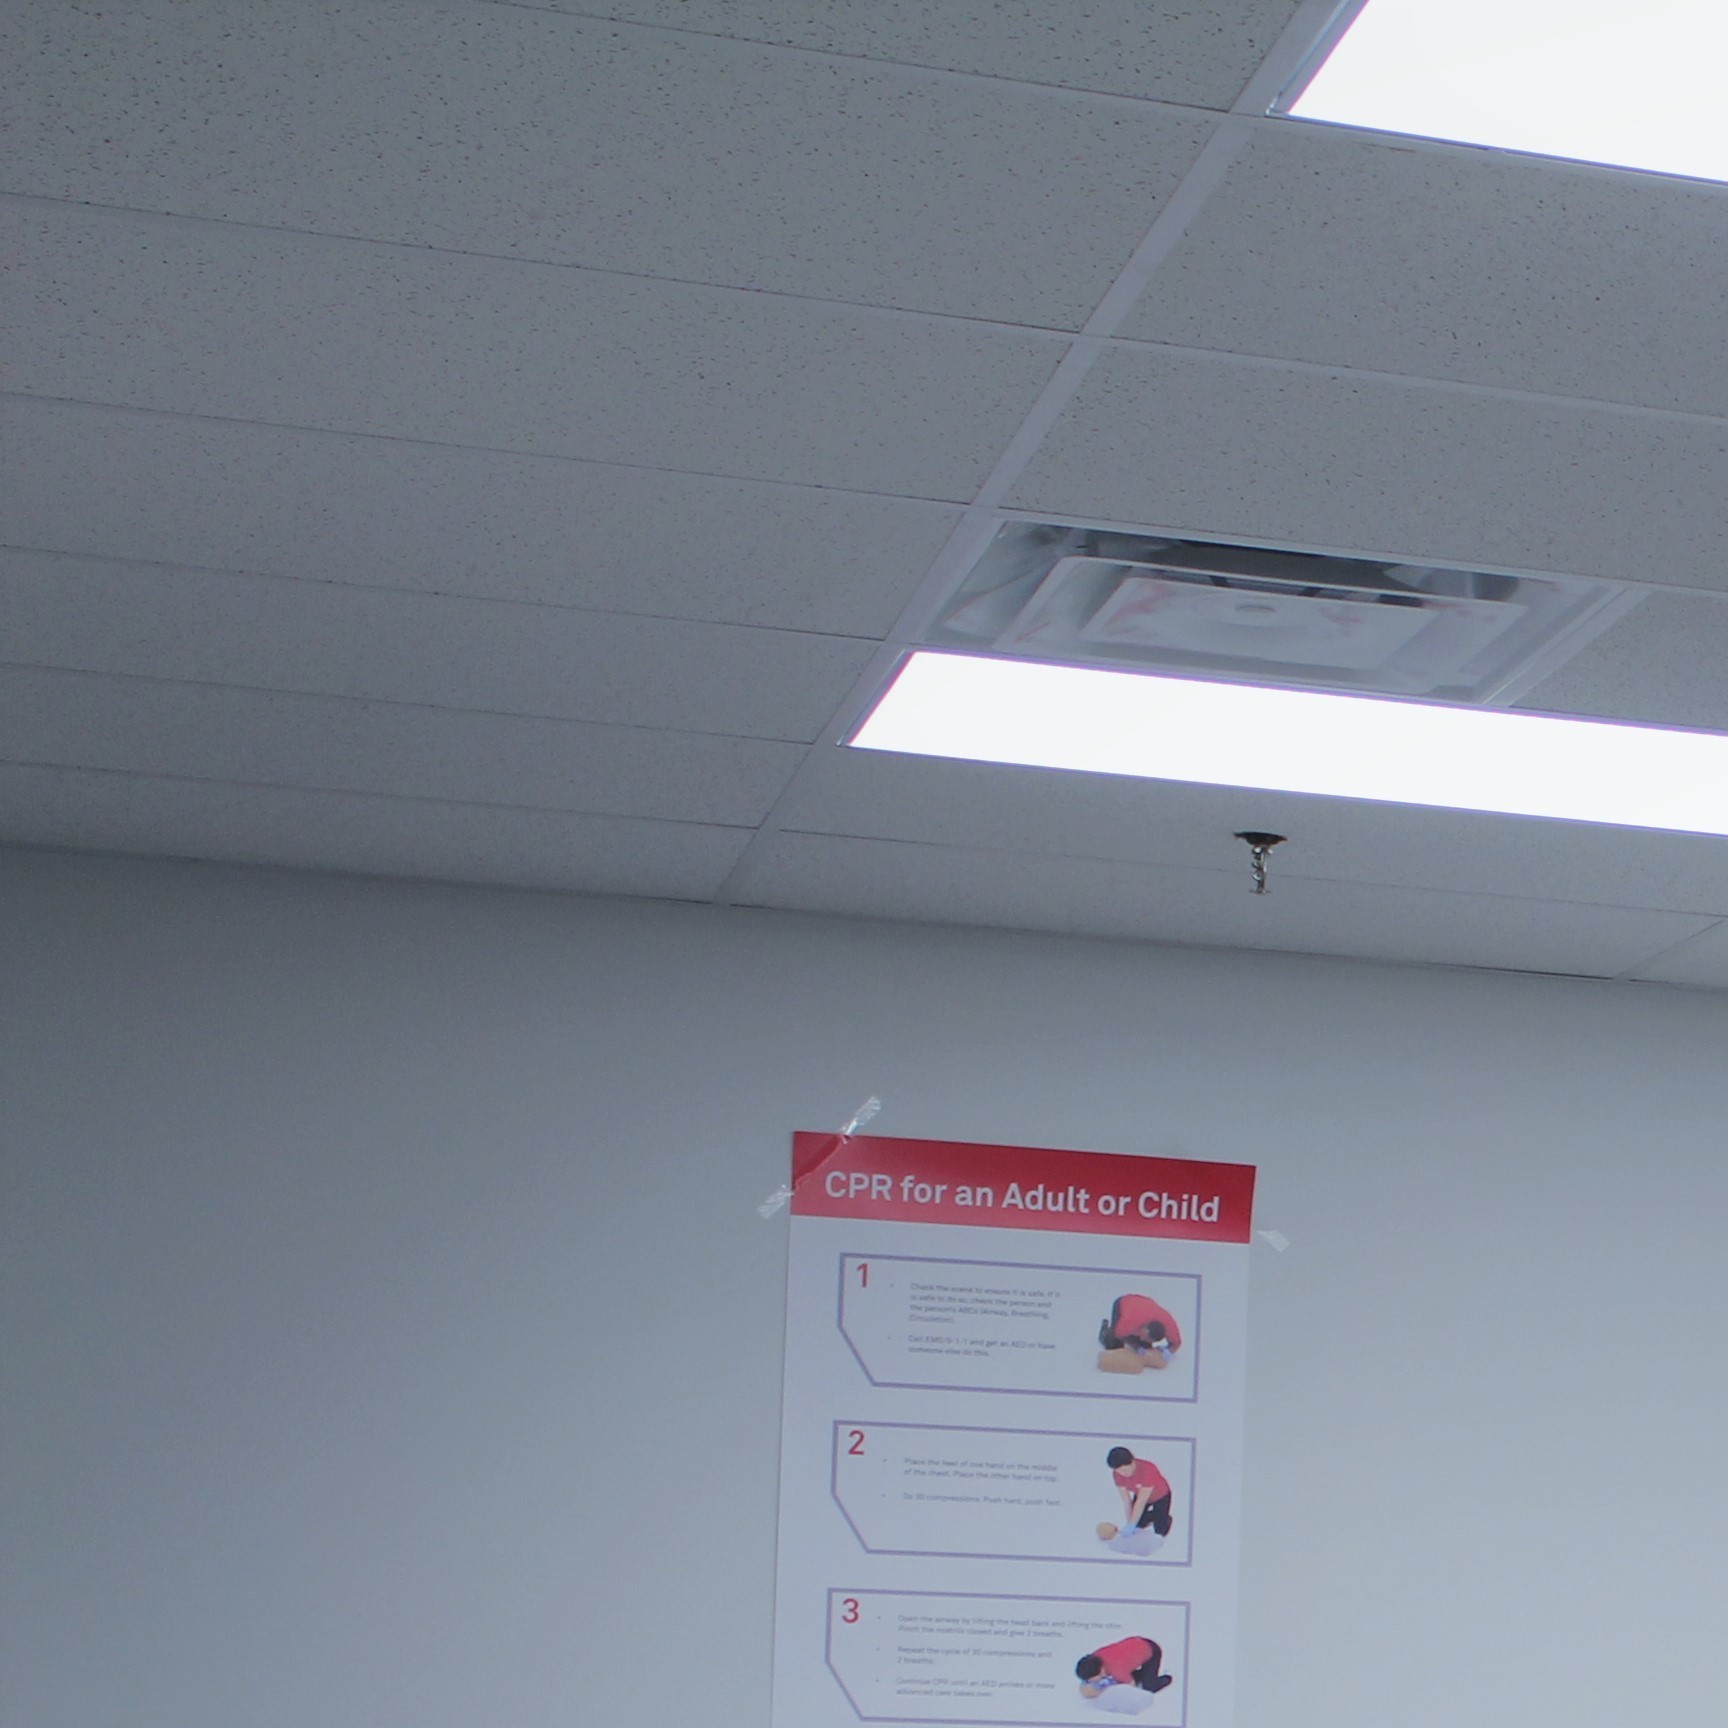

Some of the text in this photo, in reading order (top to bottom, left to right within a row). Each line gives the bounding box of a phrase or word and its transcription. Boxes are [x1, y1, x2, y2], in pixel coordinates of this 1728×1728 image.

[825, 1171, 1219, 1223] CPR for an Adult or Child
[856, 1263, 870, 1288] 1
[848, 1430, 865, 1456] 2
[841, 1598, 860, 1624] 3
